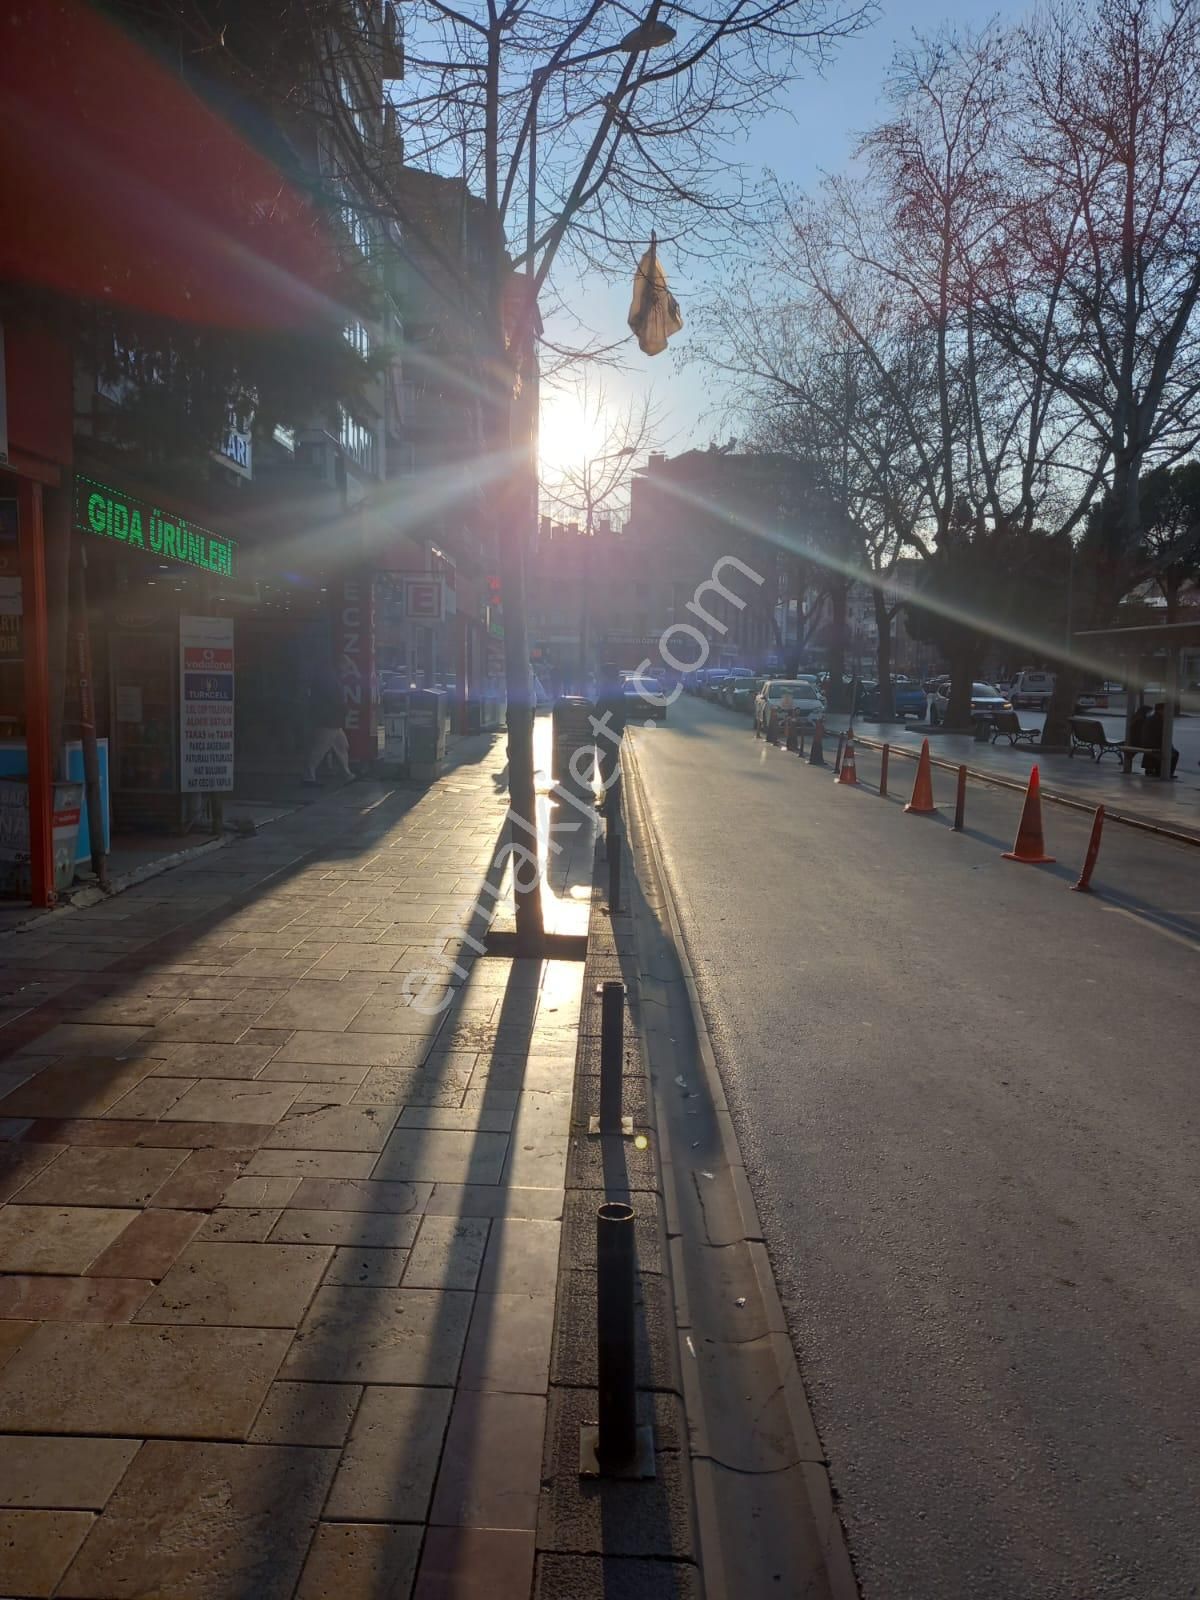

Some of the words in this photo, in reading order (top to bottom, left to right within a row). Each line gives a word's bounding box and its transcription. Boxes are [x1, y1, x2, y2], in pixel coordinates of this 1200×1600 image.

[88, 493, 144, 546] GIDA
[150, 508, 231, 577] ÜRÜNLERİ
[190, 690, 229, 699] TURKCELL
[338, 582, 361, 729] ECZANE
